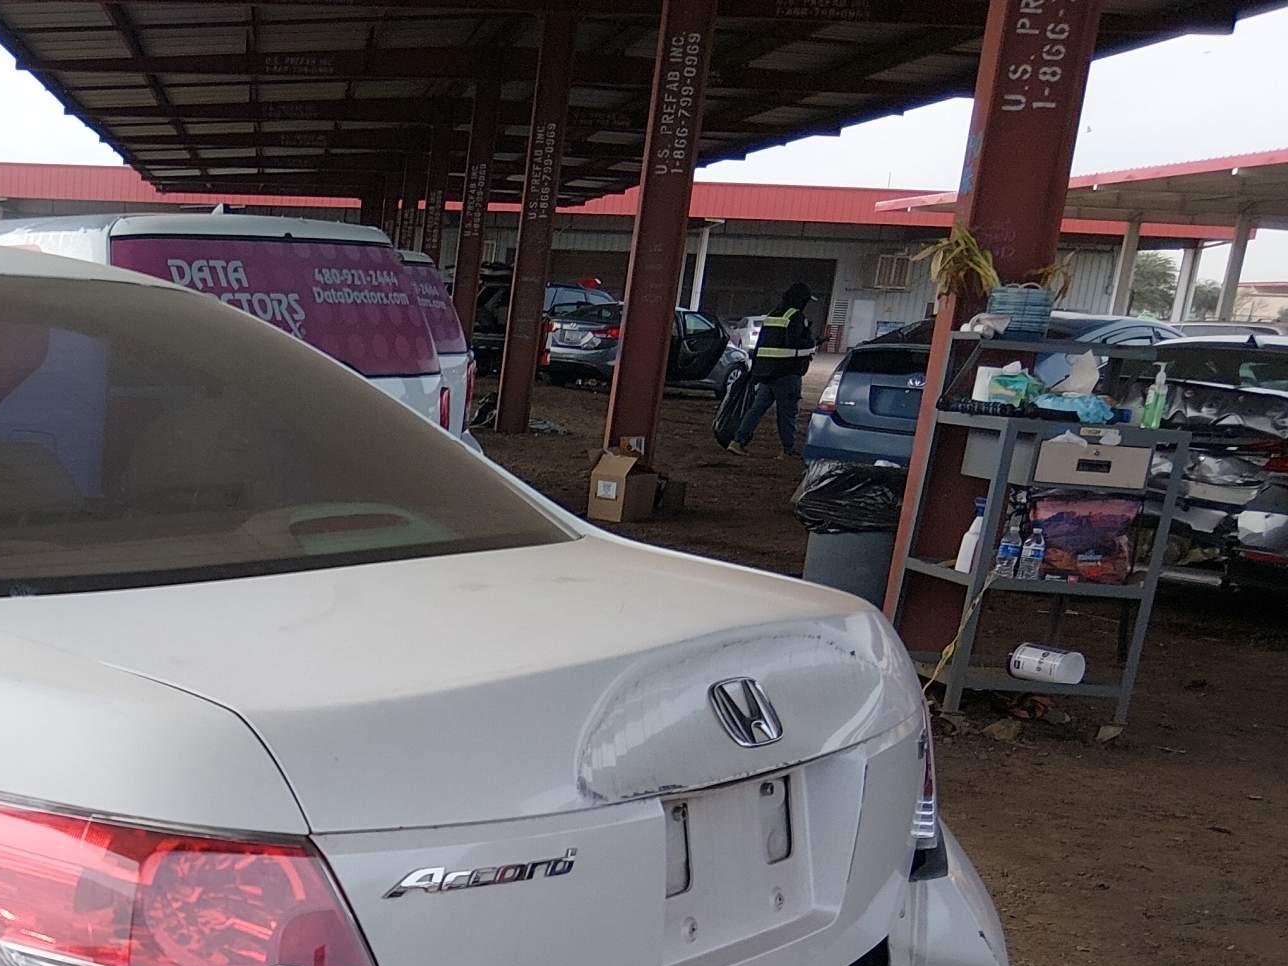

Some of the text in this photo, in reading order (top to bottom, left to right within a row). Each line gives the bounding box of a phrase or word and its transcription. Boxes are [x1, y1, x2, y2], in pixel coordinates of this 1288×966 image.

[1032, 0, 1074, 109] 1-866-
[659, 71, 681, 136] PREFAB
[670, 32, 701, 174] 1-866-799-0969
[653, 143, 672, 175] U.S.
[167, 258, 249, 291] DATA
[311, 286, 410, 305] DataDoctors.com
[380, 847, 578, 899] Accord
